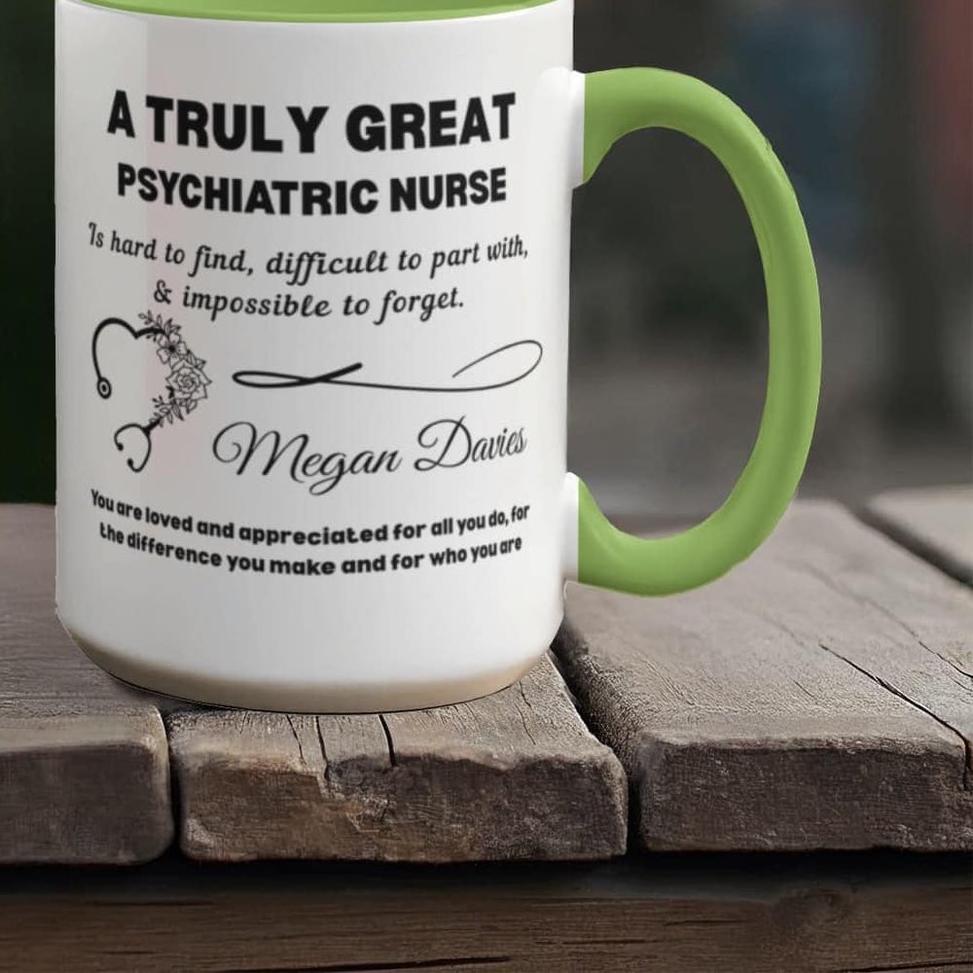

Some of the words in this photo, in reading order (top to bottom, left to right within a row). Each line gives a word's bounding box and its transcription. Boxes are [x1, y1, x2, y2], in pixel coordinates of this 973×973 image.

[106, 89, 135, 138] A
[145, 94, 329, 154] TRULY
[344, 91, 516, 152] GREAT
[117, 161, 379, 216] PSYCHIATRIC
[389, 166, 506, 212] NURSE
[88, 221, 104, 248] Is
[110, 229, 157, 260] hard
[164, 242, 185, 264] to
[187, 244, 253, 278] find,
[265, 249, 388, 286] difficult
[397, 249, 422, 271] to
[429, 242, 480, 279] part
[486, 233, 528, 261] with,
[153, 279, 172, 304] &
[182, 285, 332, 322] impossible
[342, 294, 370, 316] to
[372, 286, 463, 325] forget.
[211, 421, 402, 496] Megan
[413, 415, 527, 471] Davies
[90, 488, 114, 512] You
[115, 500, 142, 521] are
[144, 506, 193, 533] loved
[196, 520, 234, 539] and
[238, 523, 388, 546] appreciated
[392, 522, 427, 540] for
[430, 516, 453, 537] all
[455, 514, 486, 536] you
[487, 509, 509, 527] do,
[510, 504, 530, 522] for
[99, 521, 124, 544] the
[126, 531, 222, 567] difference
[225, 554, 265, 572] you
[269, 558, 336, 576] make
[340, 554, 386, 574] and
[389, 552, 425, 571] for
[428, 547, 467, 566] who
[469, 542, 497, 563] you
[498, 536, 522, 555] are
